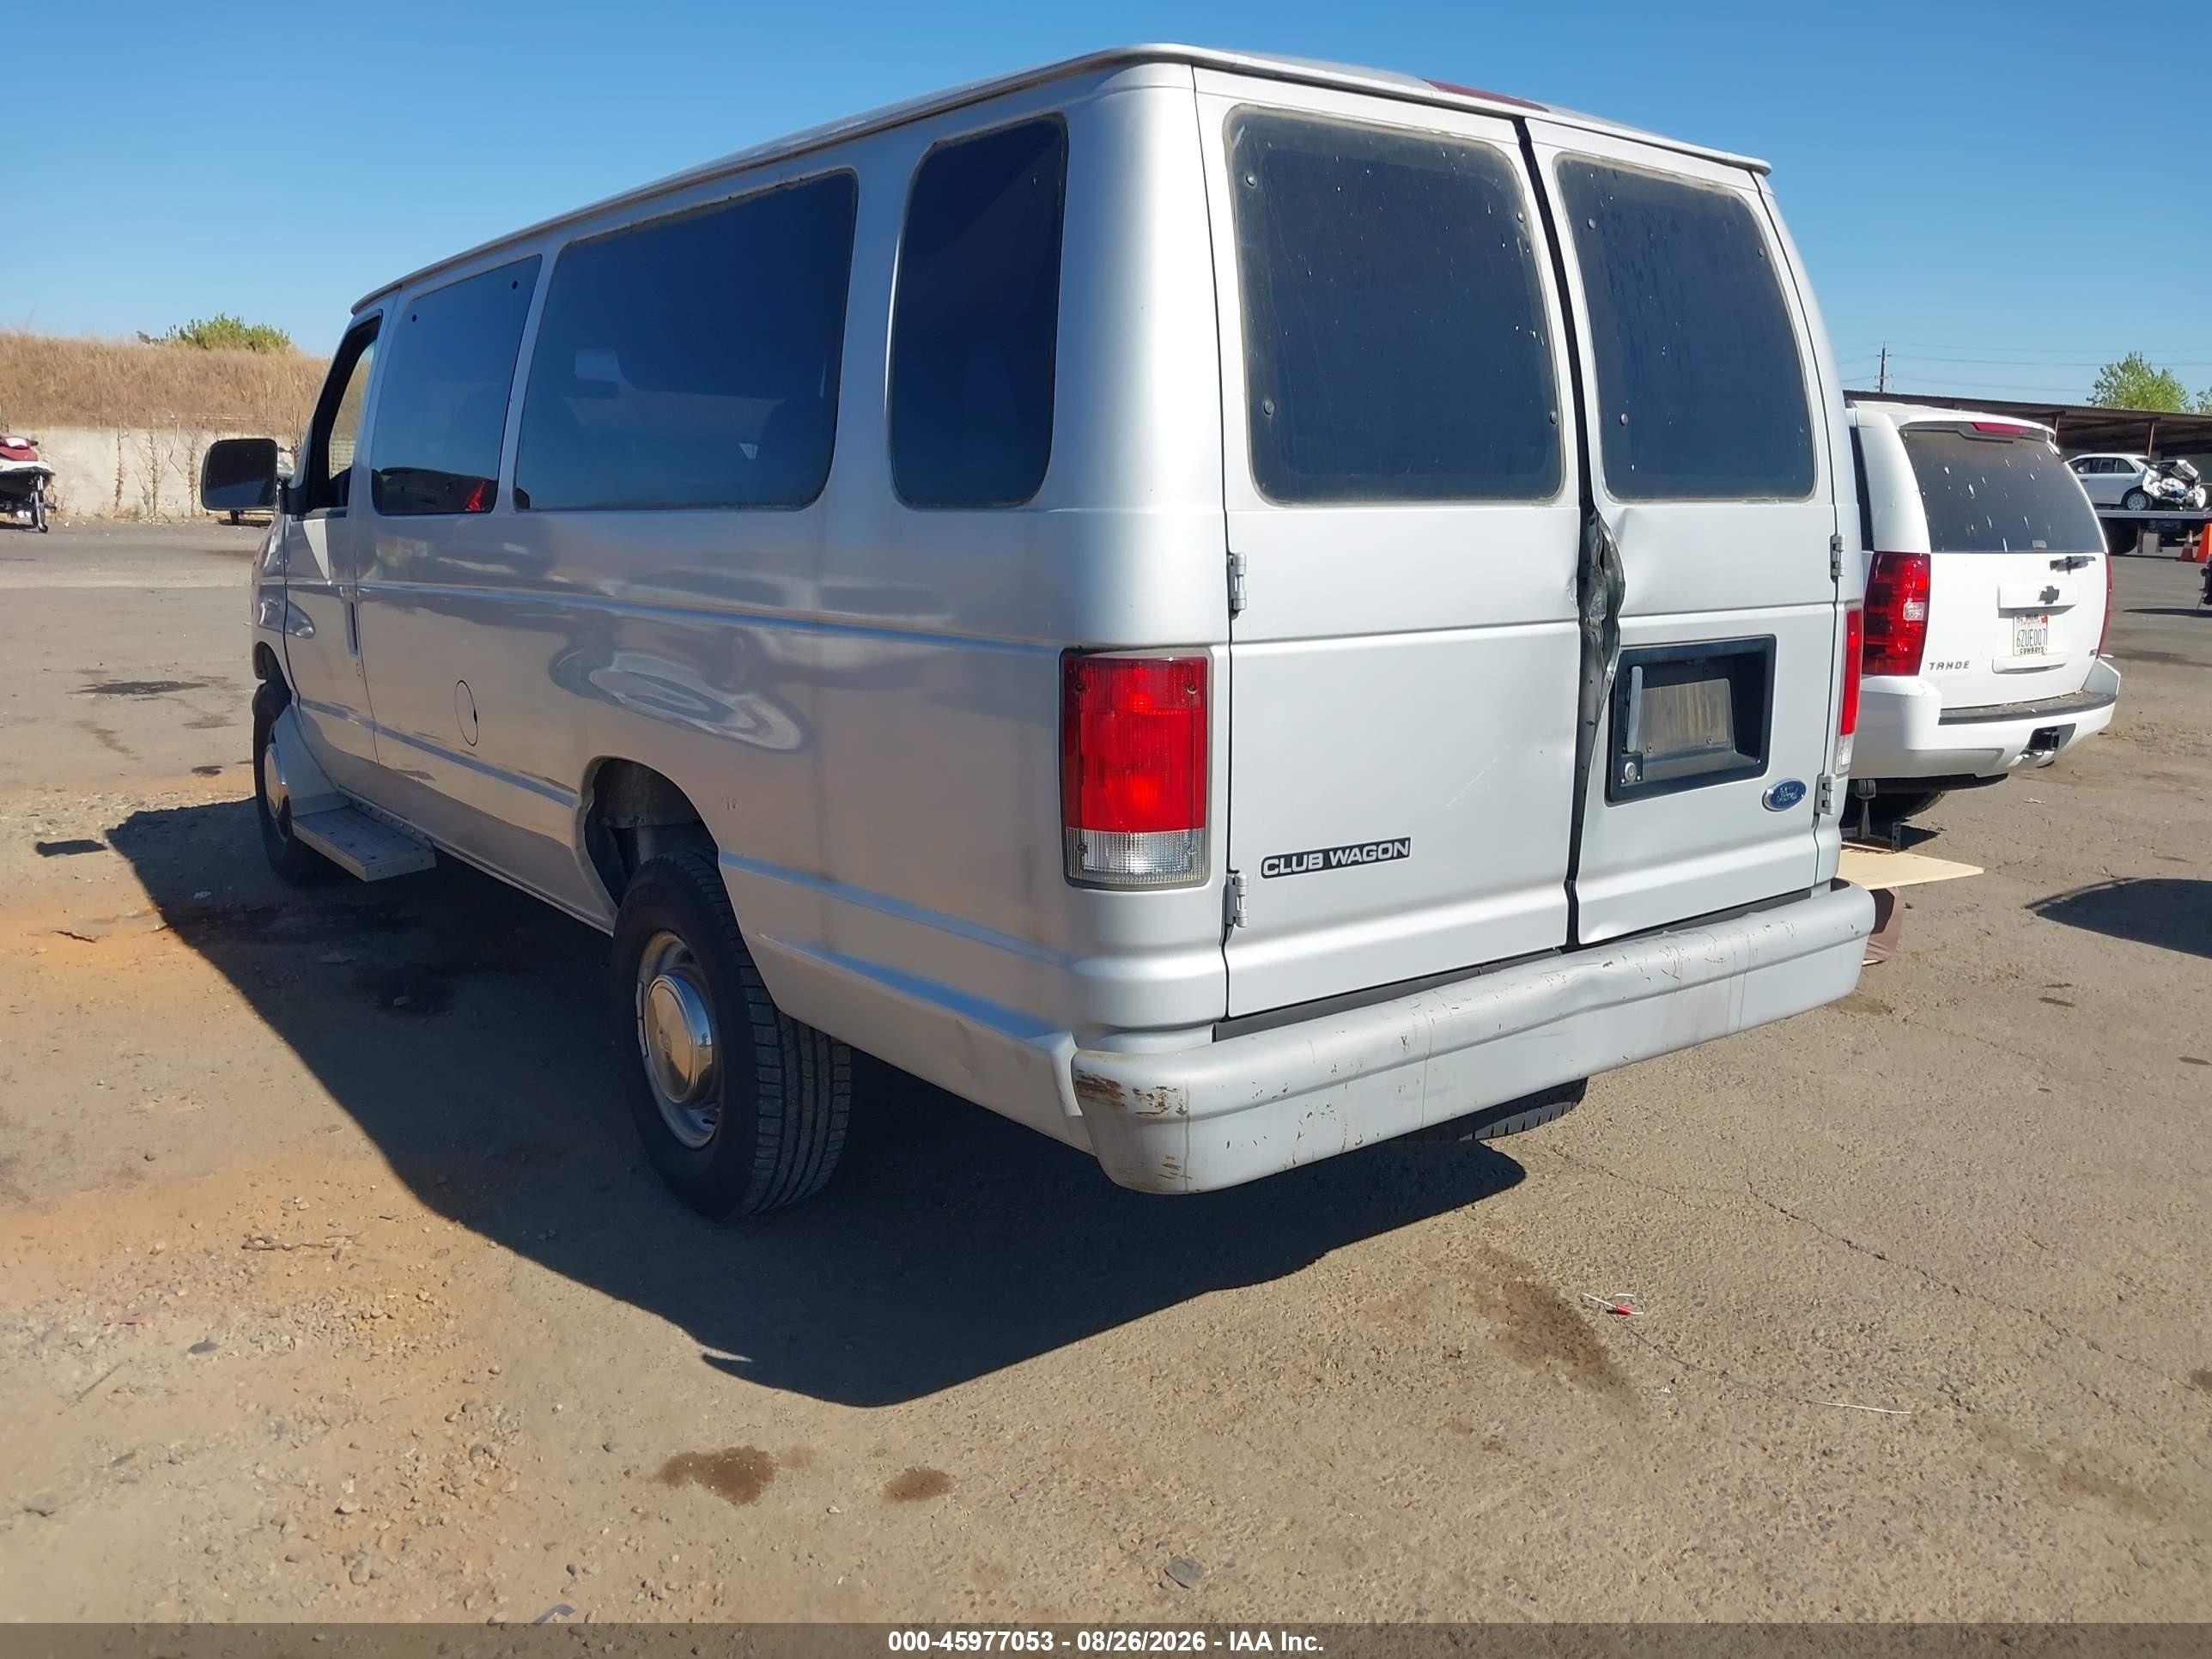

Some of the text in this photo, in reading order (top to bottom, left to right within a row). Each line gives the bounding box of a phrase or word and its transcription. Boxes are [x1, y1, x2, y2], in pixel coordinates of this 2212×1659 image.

[2016, 628, 2046, 647] 6ZUE007
[1929, 660, 1970, 671] TAHOE
[1263, 840, 1409, 876] CLUB WAGON
